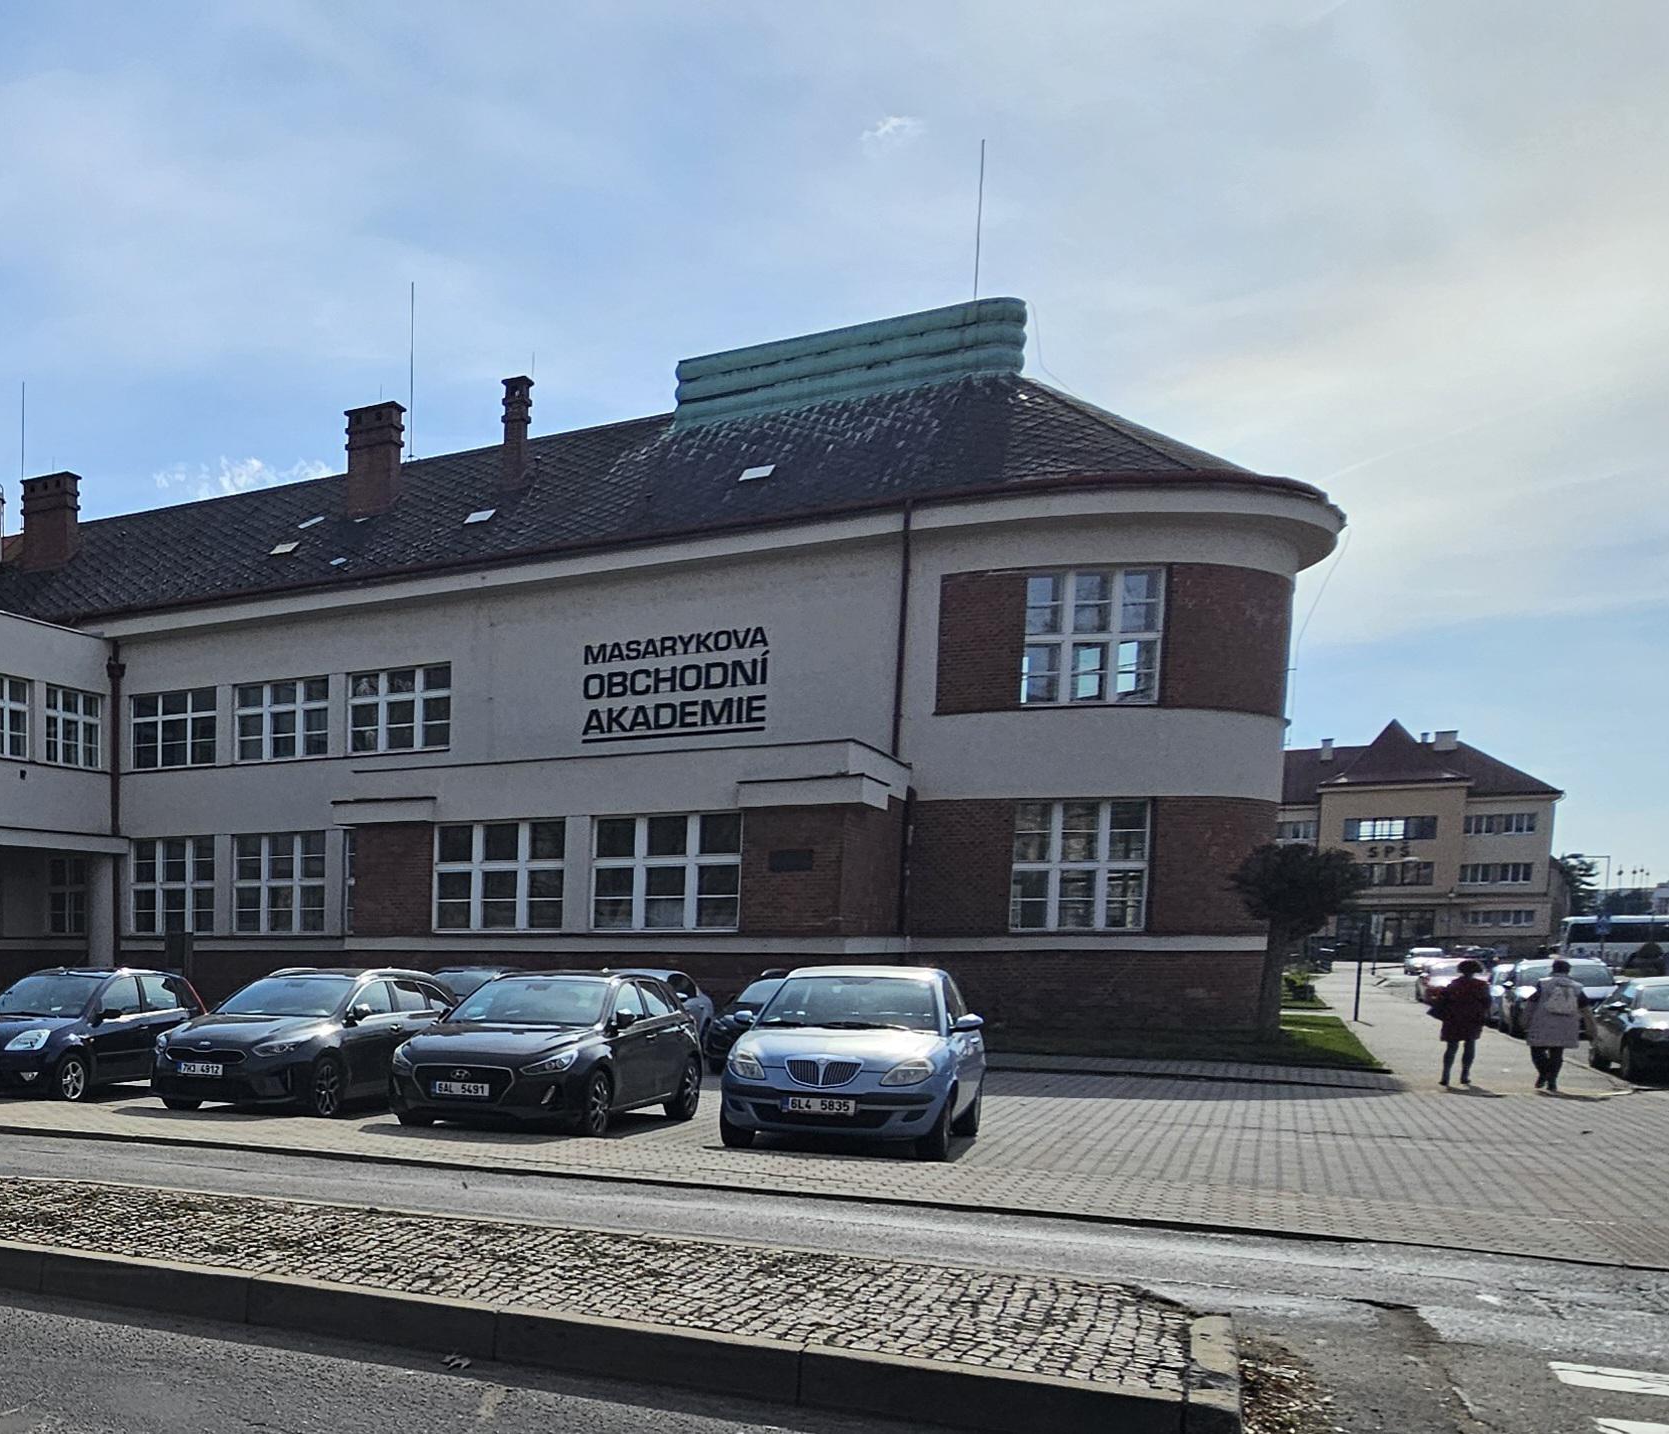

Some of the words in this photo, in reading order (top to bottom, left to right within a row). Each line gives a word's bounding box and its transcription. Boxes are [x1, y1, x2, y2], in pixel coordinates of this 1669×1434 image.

[583, 626, 769, 666] MASARYKOVA
[582, 650, 770, 700] OBCHODNÍ
[581, 694, 767, 736] AKADEMIE
[461, 1083, 485, 1095] 5491
[791, 1098, 812, 1110] 6L4
[820, 1099, 850, 1112] 5835
